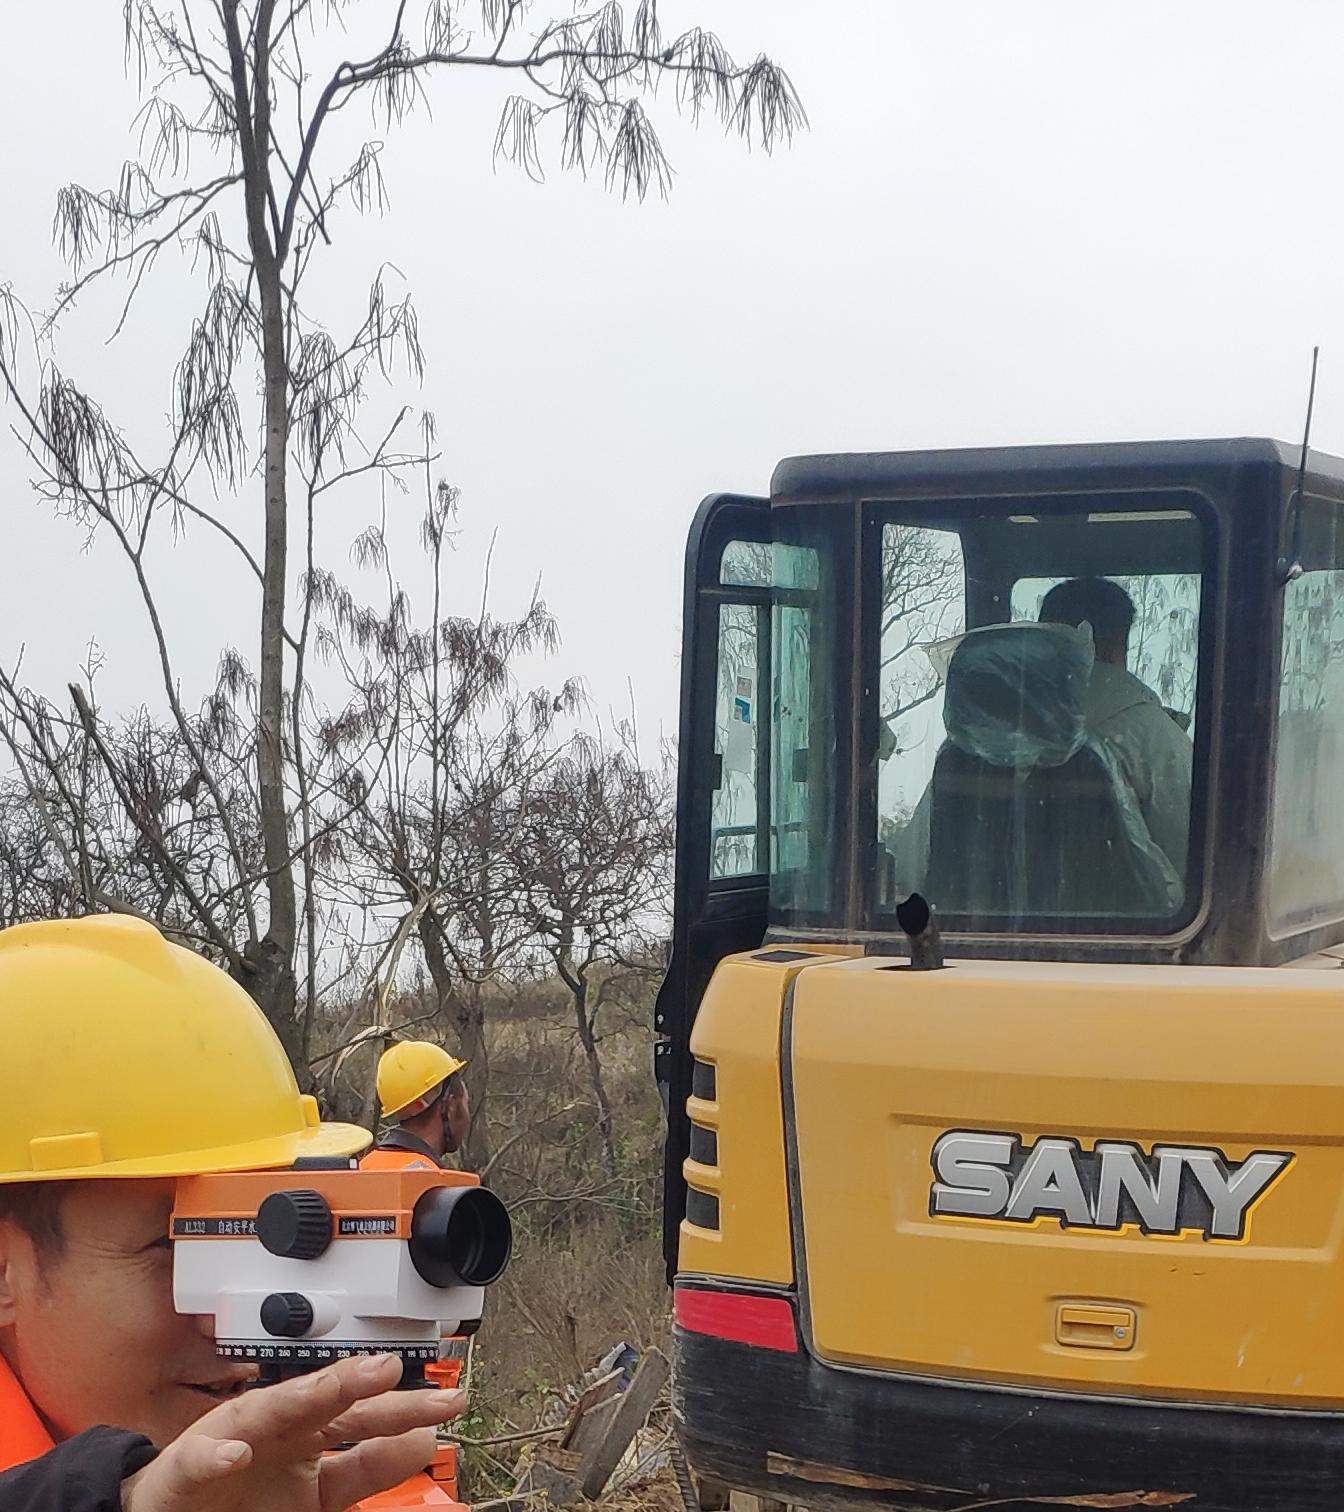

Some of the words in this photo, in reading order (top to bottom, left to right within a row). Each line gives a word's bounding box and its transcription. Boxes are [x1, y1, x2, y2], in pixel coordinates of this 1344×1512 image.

[930, 1130, 1296, 1240] SANY
[260, 1348, 274, 1358] 270
[278, 1349, 291, 1357] 260
[297, 1349, 311, 1358] 250
[317, 1349, 331, 1358] 240
[337, 1349, 351, 1358] 230
